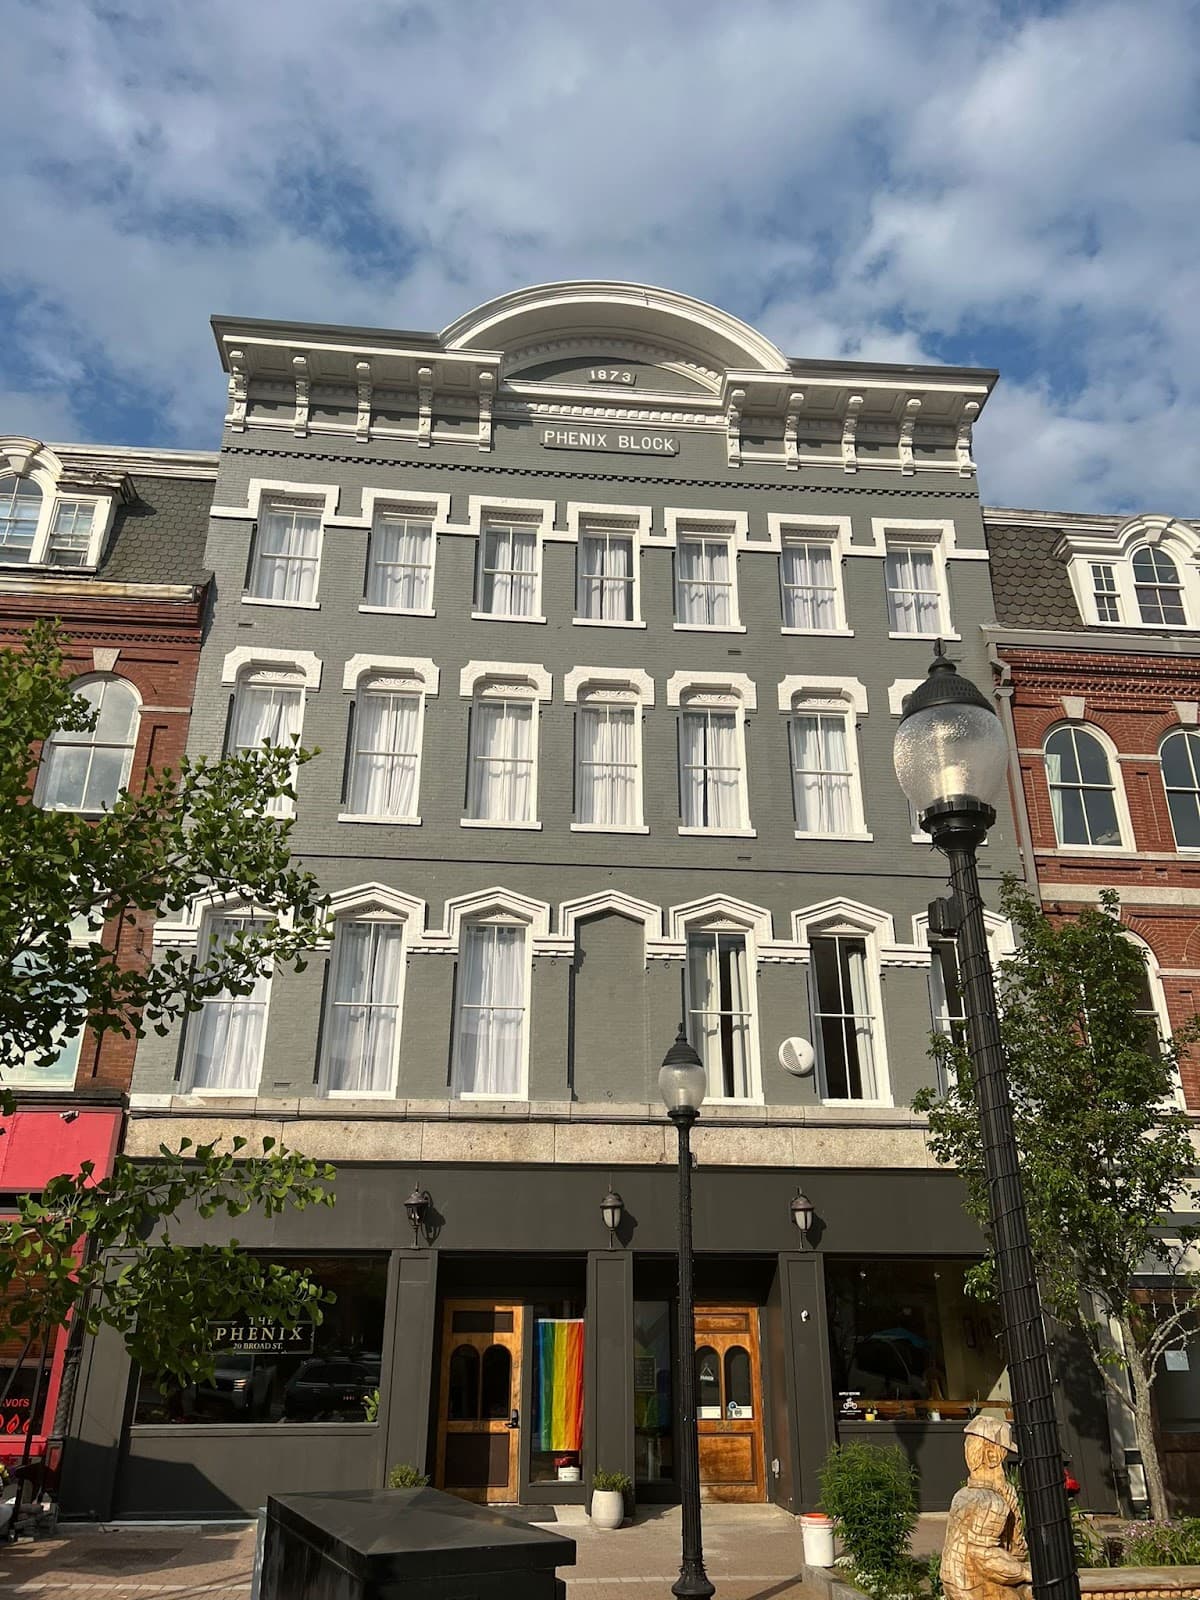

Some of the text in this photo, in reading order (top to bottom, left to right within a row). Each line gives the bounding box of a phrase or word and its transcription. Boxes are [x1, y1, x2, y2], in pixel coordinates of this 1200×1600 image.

[590, 370, 631, 382] 1873
[543, 430, 676, 452] PHENIX BLOCK
[216, 1327, 303, 1341] PHENIX
[243, 1342, 271, 1350] BROAD
